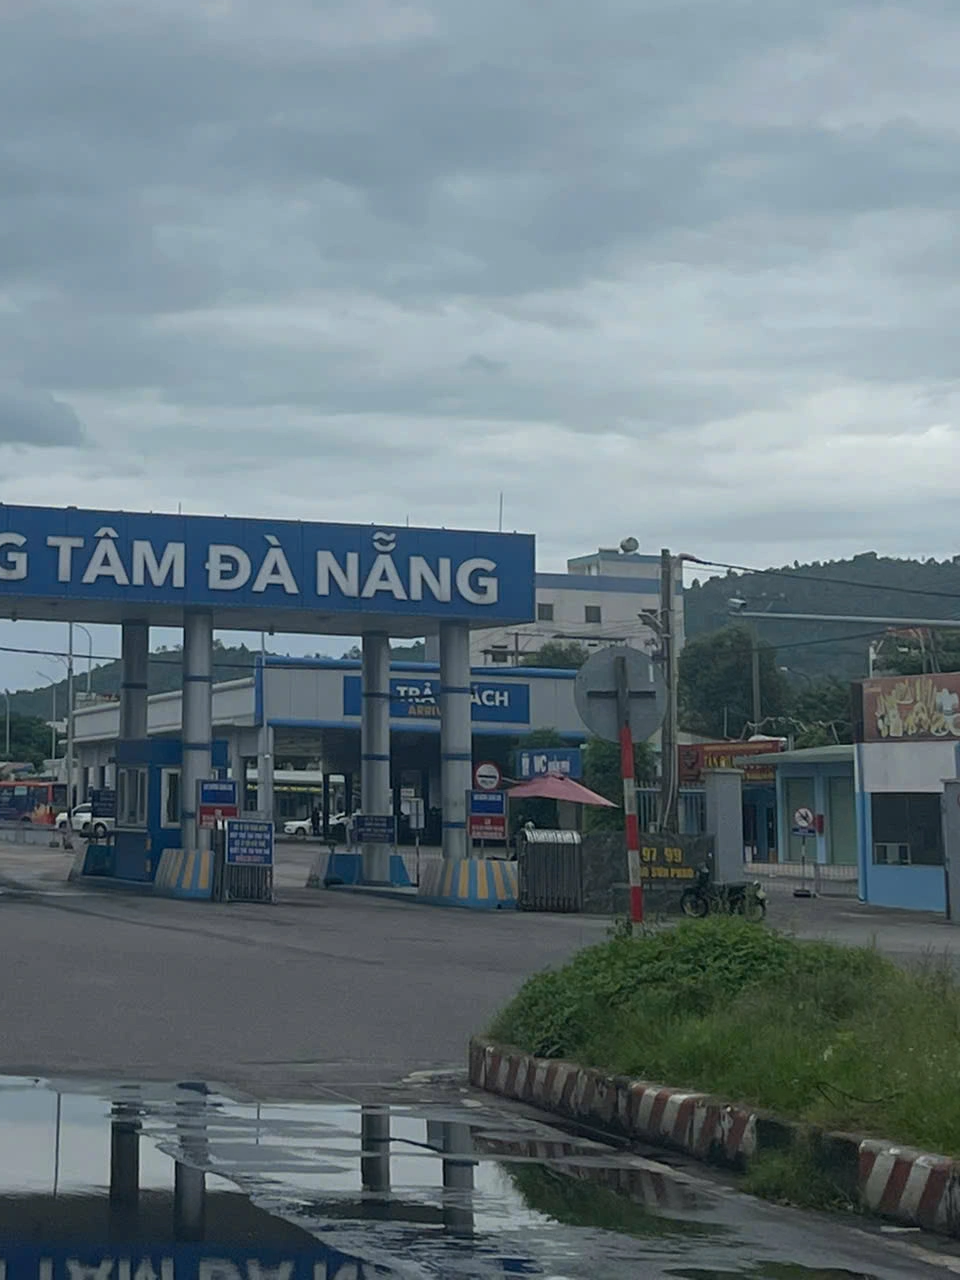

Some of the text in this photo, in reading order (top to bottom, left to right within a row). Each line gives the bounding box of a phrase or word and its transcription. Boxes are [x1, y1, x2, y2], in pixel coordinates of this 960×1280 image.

[46, 526, 185, 588] TÂM
[205, 534, 299, 595] ĐÀ
[317, 531, 499, 605] NẴNG
[642, 847, 683, 863] 97 99
